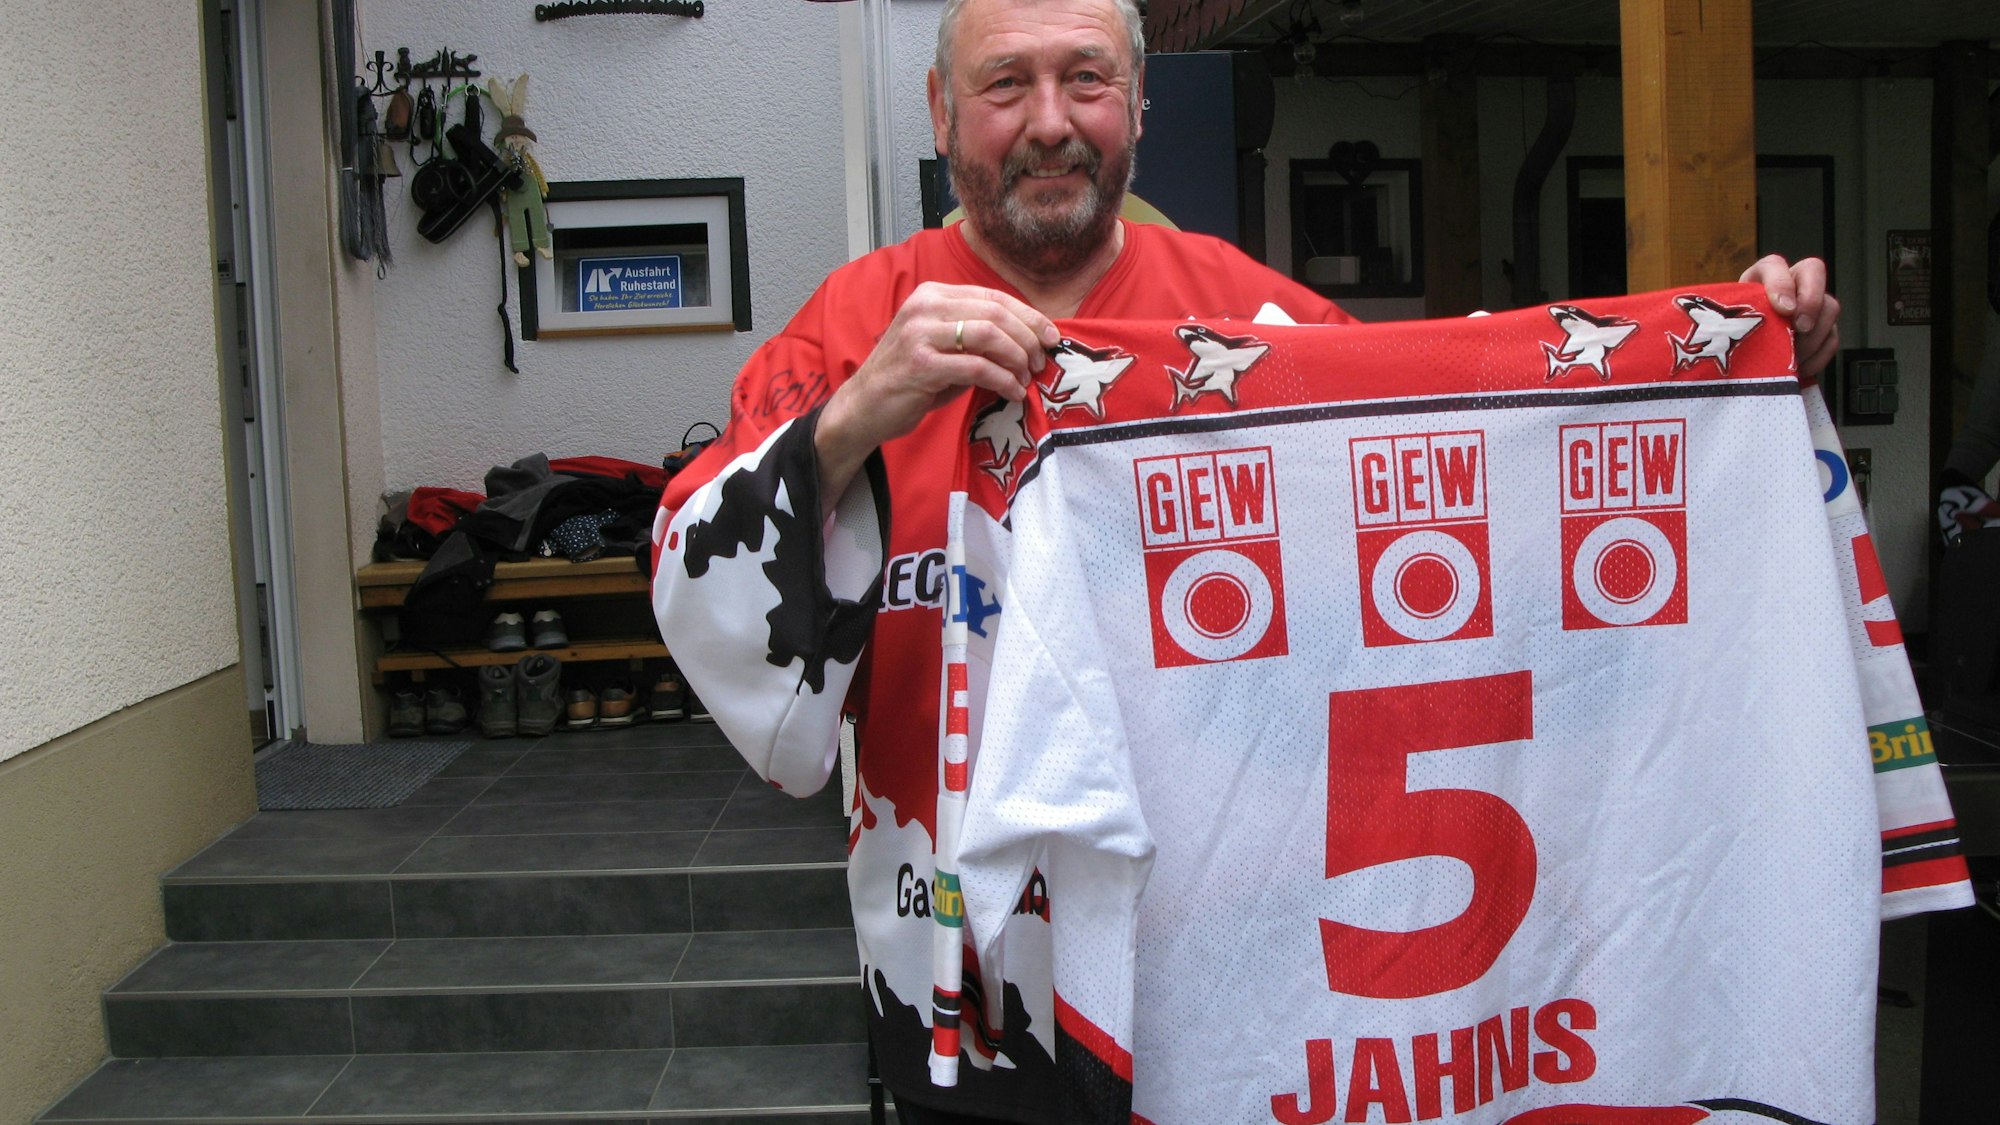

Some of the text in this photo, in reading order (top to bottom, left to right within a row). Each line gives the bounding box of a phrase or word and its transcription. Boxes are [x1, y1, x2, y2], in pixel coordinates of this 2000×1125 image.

[620, 279, 676, 292] Ruhestand
[625, 267, 671, 278] Ausfahrt
[1146, 462, 1265, 536] GEW
[1360, 444, 1478, 515] GEW
[1568, 434, 1680, 501] GEW
[1318, 669, 1538, 1000] 5
[1271, 998, 1597, 1125] JAHNS
